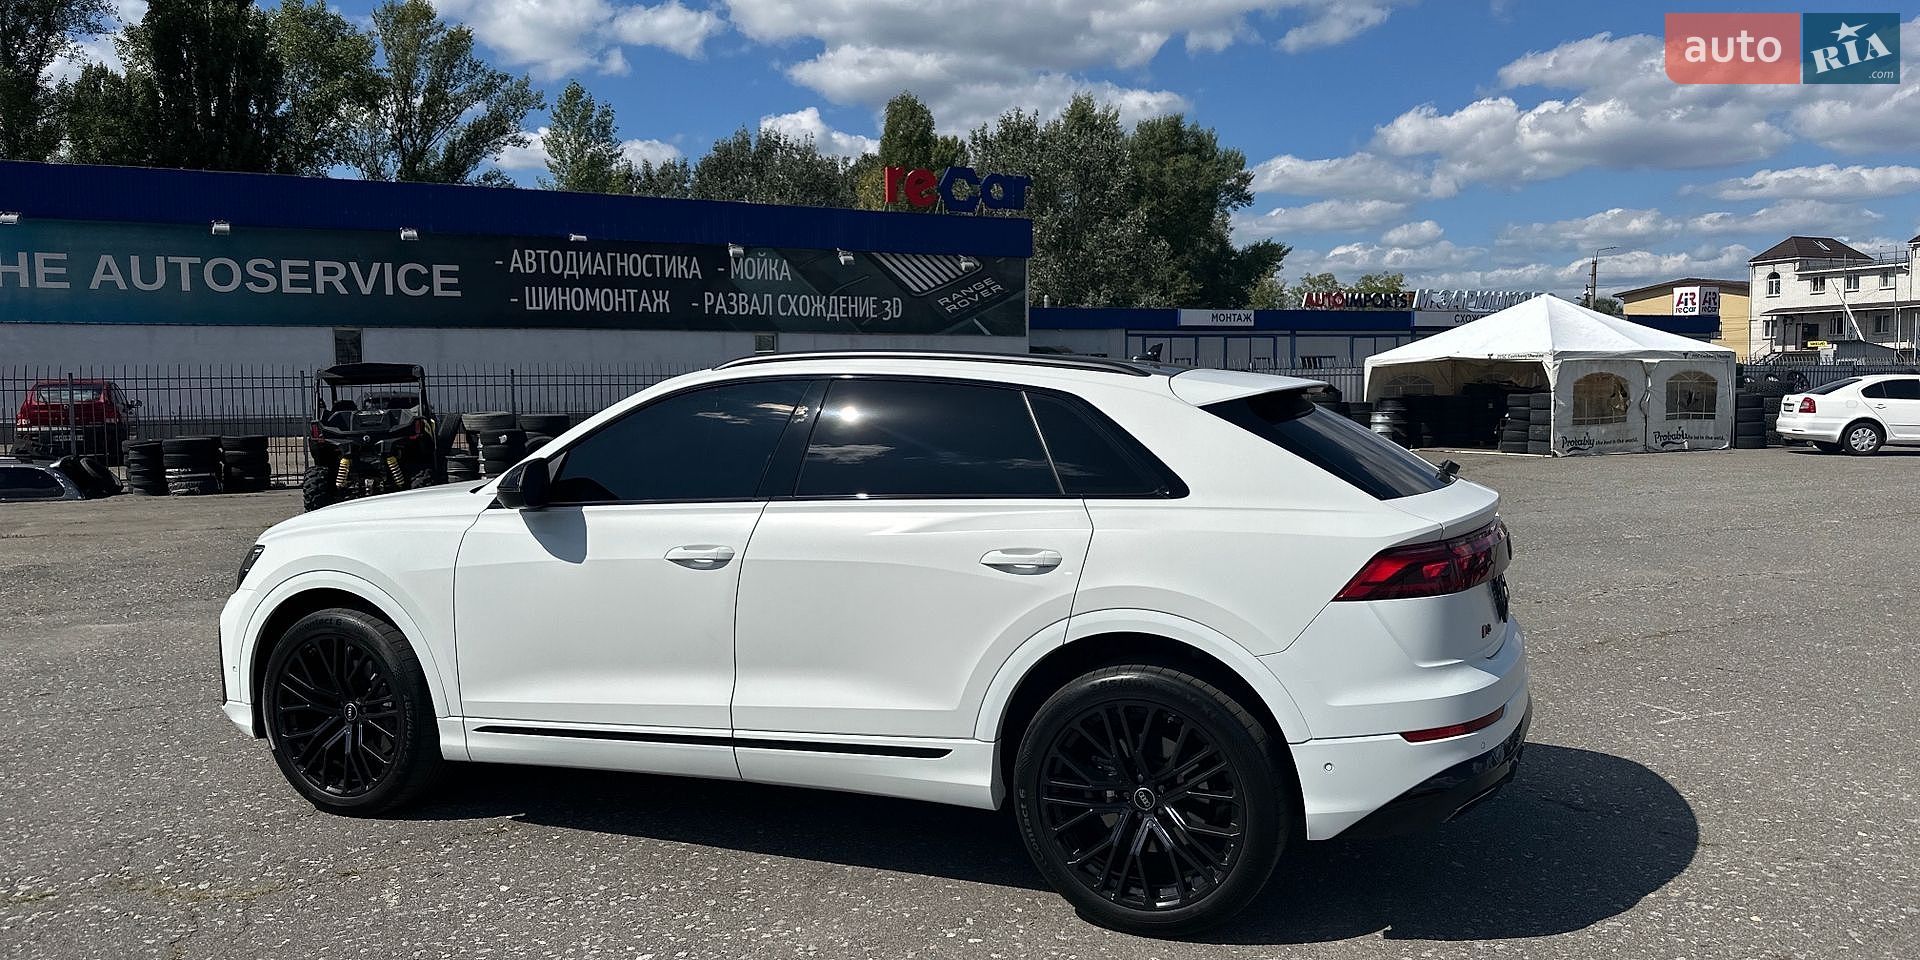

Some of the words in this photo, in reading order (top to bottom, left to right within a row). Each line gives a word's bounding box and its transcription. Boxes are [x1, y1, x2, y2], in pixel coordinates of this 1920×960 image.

[884, 166, 1032, 212] reCar
[89, 254, 462, 297] AUTOSERVICE
[509, 249, 702, 279] АВТОДИАГНОСТИКА
[730, 252, 792, 281] МОЙКА
[525, 286, 670, 313] ШИНОМОНТАЖ
[938, 277, 996, 306] RANGE
[945, 284, 1004, 313] ROVER
[704, 292, 773, 316] РАЗВАЛ
[777, 294, 878, 321] СХОЖДЕНИЕ
[880, 297, 903, 321] 3D
[1211, 313, 1253, 323] МОНТАЖ
